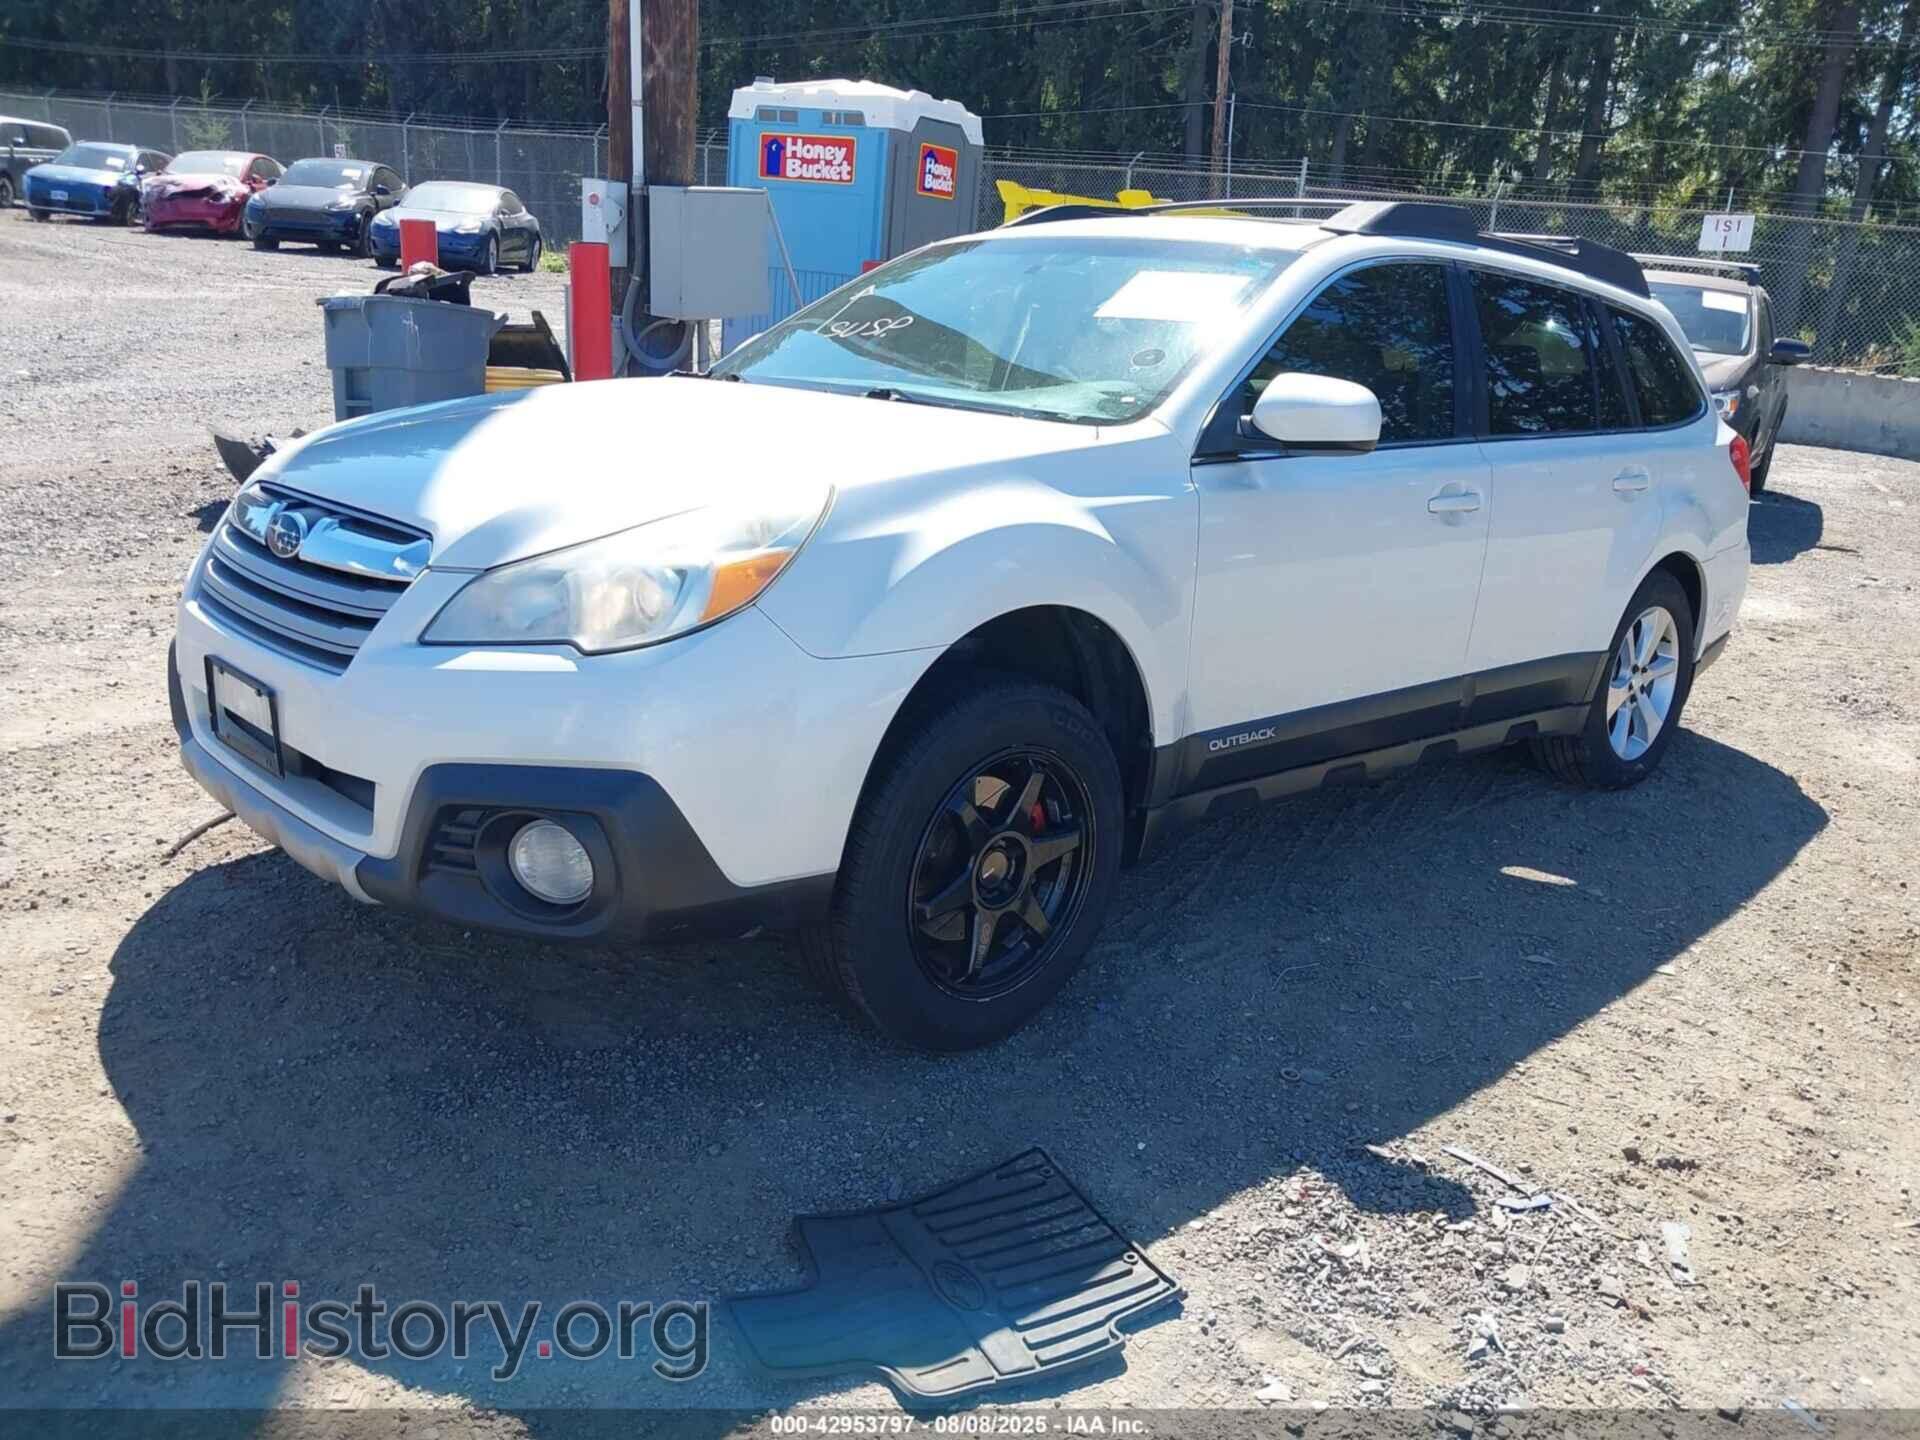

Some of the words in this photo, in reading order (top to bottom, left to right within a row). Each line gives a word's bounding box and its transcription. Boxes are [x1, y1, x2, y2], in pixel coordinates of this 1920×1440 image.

[785, 138, 848, 162] Honey
[786, 159, 851, 180] Bucket
[926, 157, 953, 181] Honey
[924, 172, 953, 192] Bucket
[1209, 727, 1277, 751] OUTBACK
